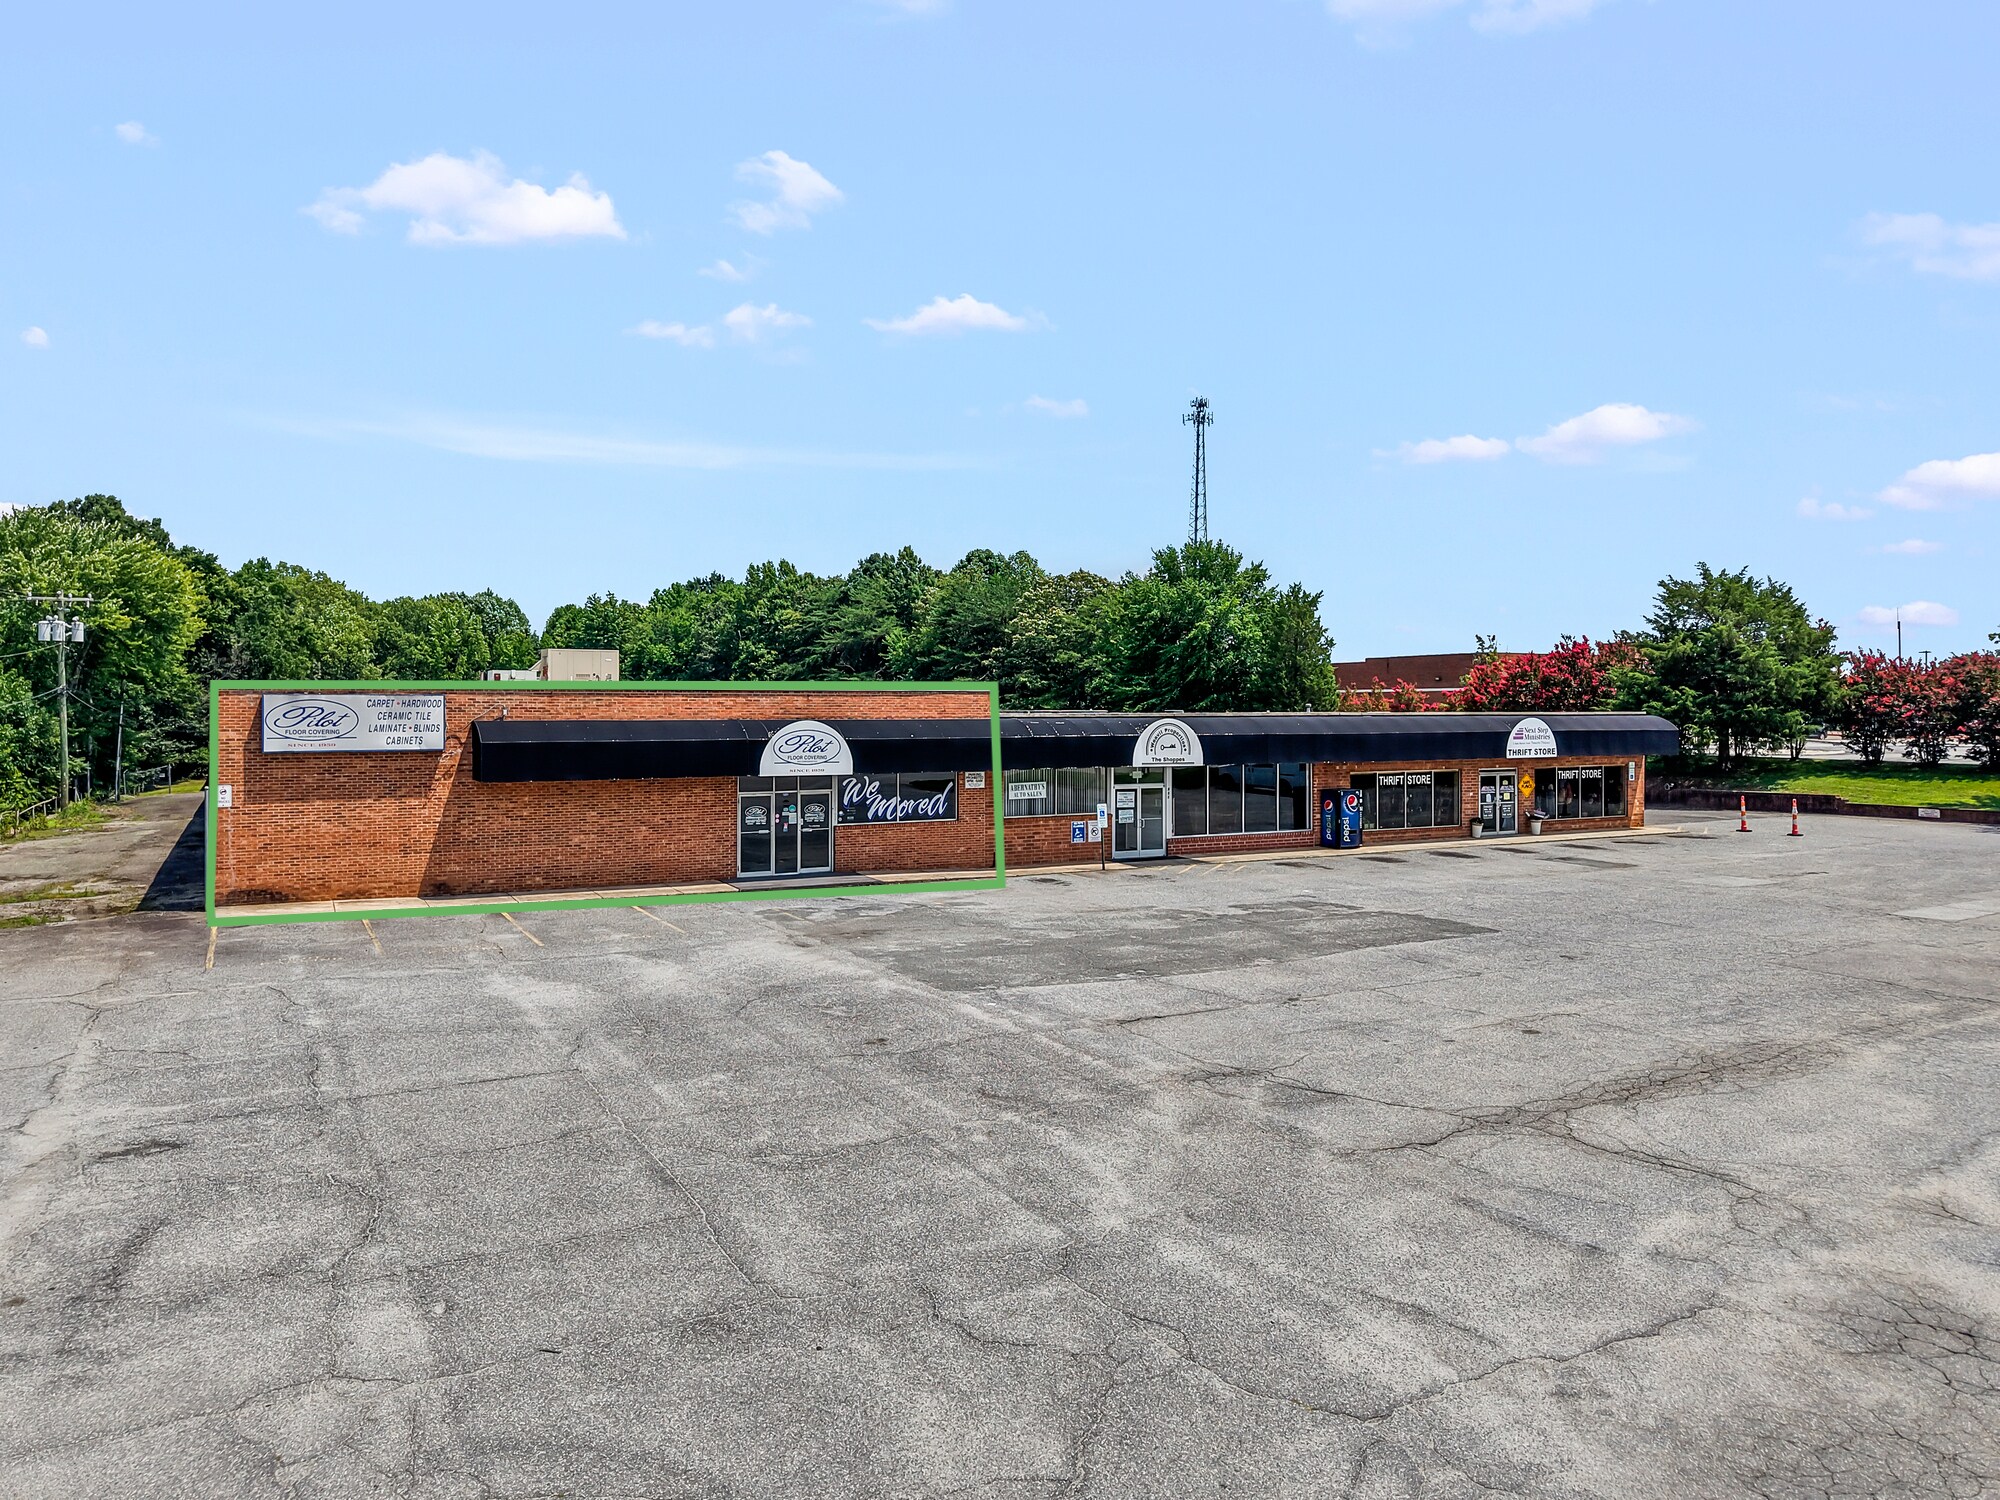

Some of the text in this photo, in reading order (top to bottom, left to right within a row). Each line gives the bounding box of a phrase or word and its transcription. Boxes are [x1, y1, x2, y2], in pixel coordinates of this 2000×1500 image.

[366, 699, 442, 708] CARPET HARDWOOD
[273, 706, 350, 728] Pilot
[377, 711, 431, 720] CERAMIC TILE
[368, 723, 441, 732] LAMINATE BLINDS
[1537, 727, 1549, 735] Step
[385, 736, 423, 745] CABINETS
[778, 734, 834, 754] Pilot
[1508, 748, 1533, 756] THRIFT
[1558, 769, 1602, 779] THRIFT STORE
[1379, 774, 1431, 786] THRIFT STORE
[842, 776, 880, 807] We
[1010, 783, 1045, 792] ABERNATHY'S
[1341, 817, 1350, 842] pepsi
